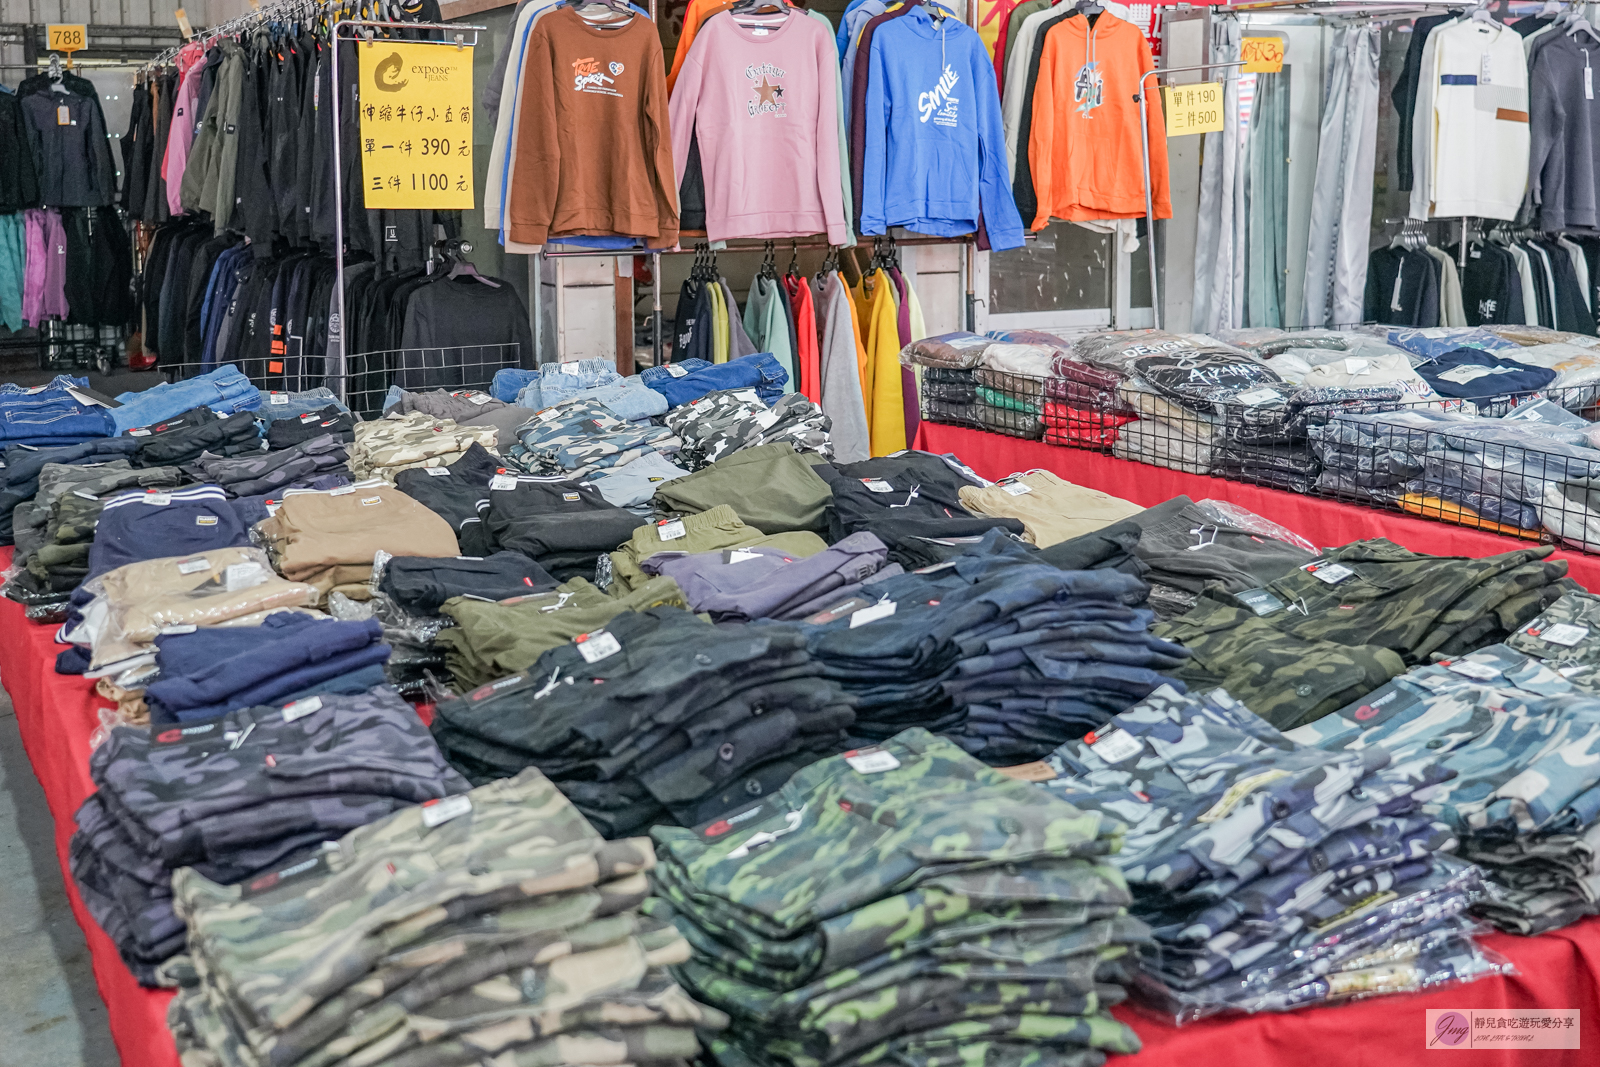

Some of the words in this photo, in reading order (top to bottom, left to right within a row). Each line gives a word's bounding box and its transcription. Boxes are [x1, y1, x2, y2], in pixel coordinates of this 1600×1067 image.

[53, 30, 82, 45] 788
[411, 65, 450, 78] expose
[428, 74, 449, 82] JEANS
[1197, 89, 1216, 103] 190
[1198, 110, 1217, 124] 500
[421, 138, 450, 155] 390
[458, 140, 471, 156] 元
[371, 174, 402, 193] 三件
[411, 173, 449, 190] 1100
[456, 175, 469, 191] 元
[1121, 339, 1192, 359] DESIGN
